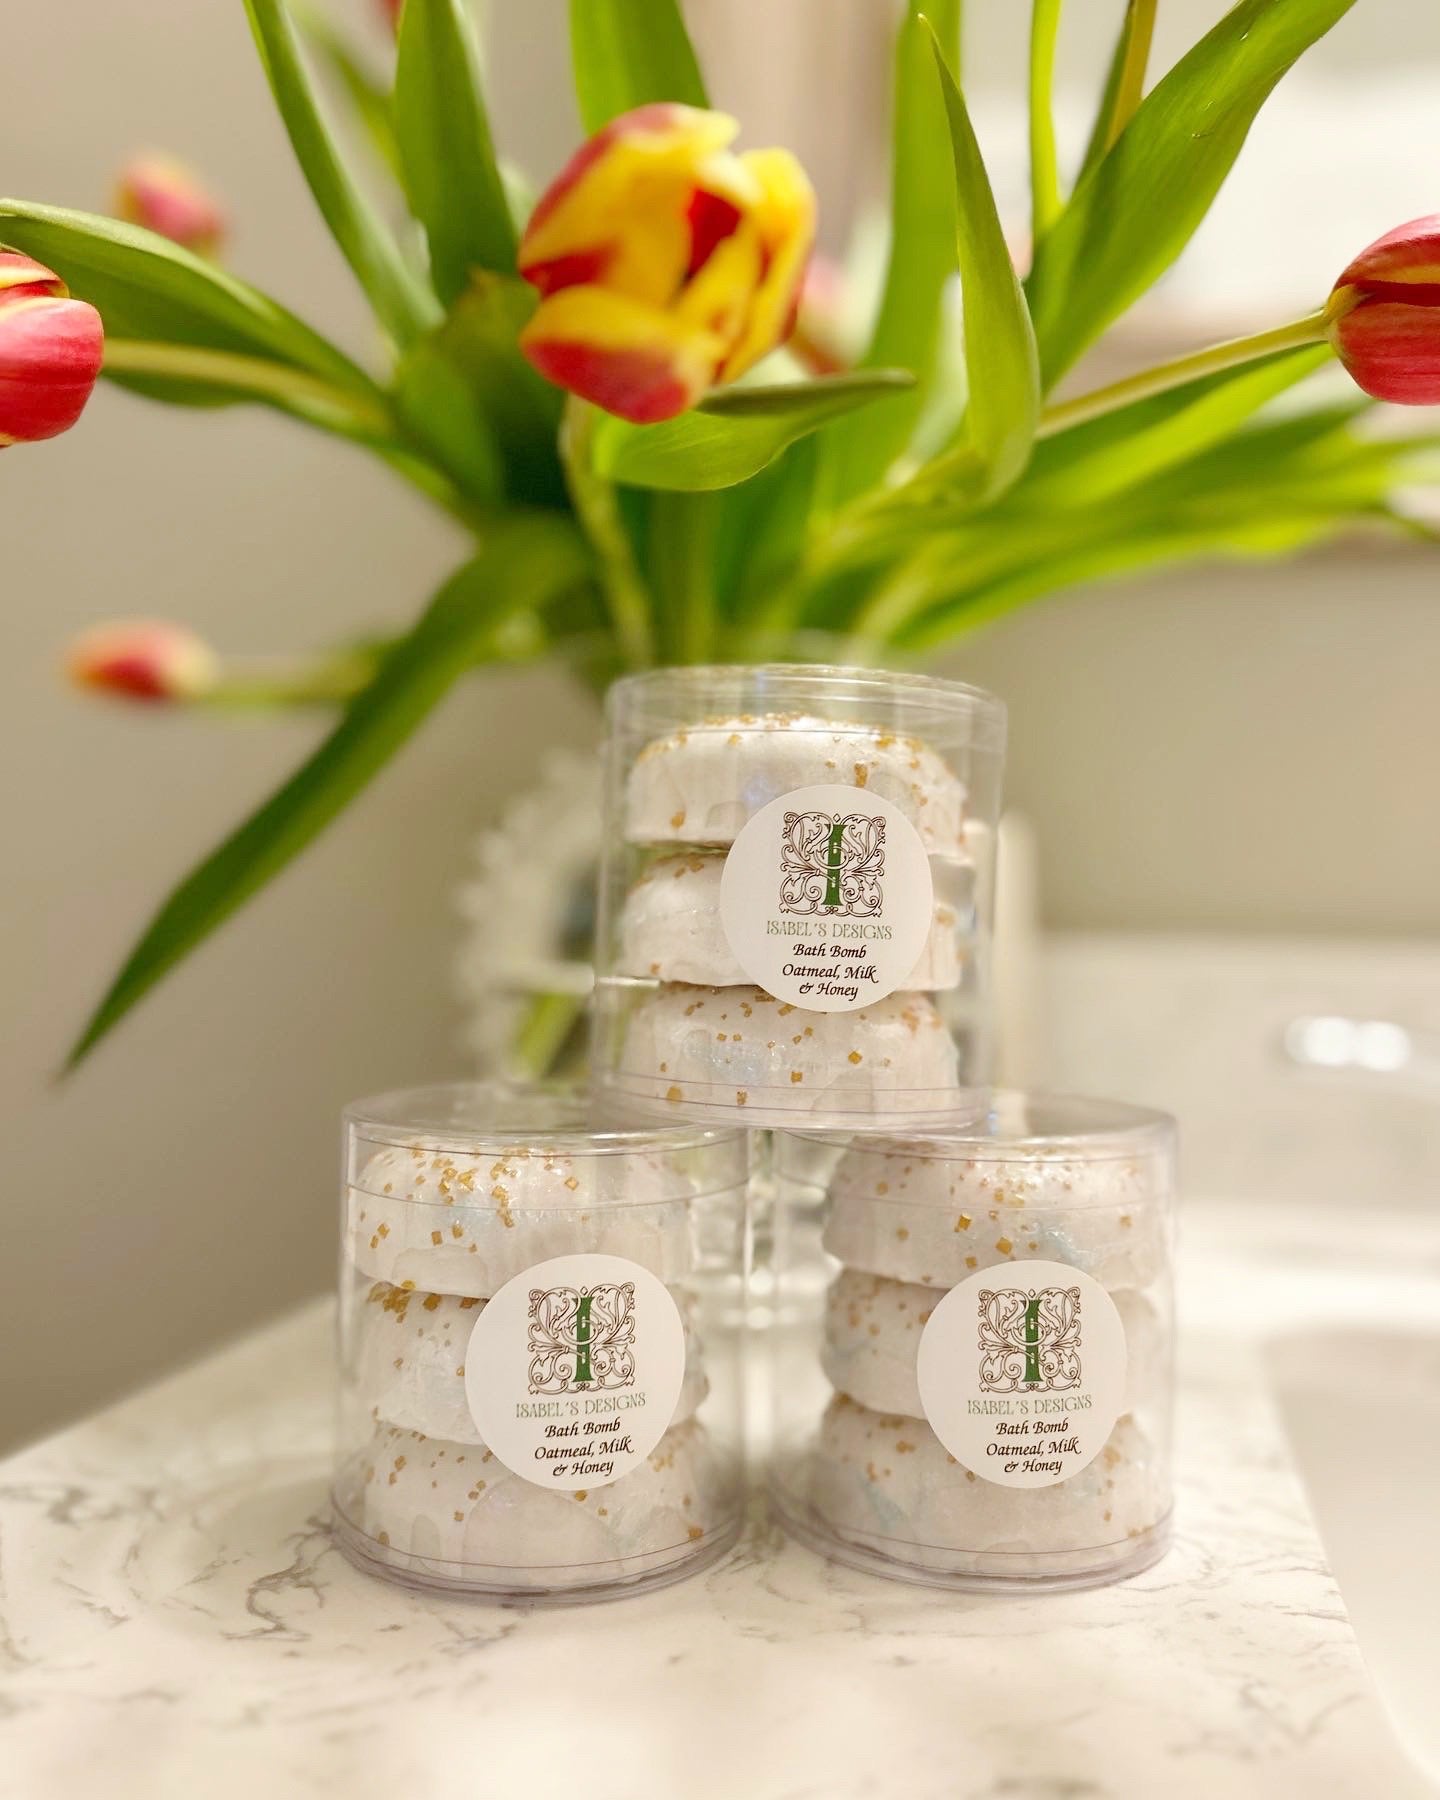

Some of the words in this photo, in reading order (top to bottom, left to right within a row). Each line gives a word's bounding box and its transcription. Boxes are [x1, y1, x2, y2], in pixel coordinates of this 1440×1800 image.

[767, 920, 827, 937] ISABEL'S
[832, 923, 892, 940] DESIGNS
[793, 943, 826, 957] Bath
[830, 945, 866, 958] Bomb
[783, 964, 840, 980] Oatmeal,
[844, 966, 879, 983] Milk
[800, 983, 814, 994] &
[817, 983, 858, 1001] Honey
[516, 1401, 579, 1418] ISABEL'S
[585, 1392, 646, 1415] DESIGNS
[968, 1399, 1028, 1415] ISABEL'S
[1034, 1394, 1092, 1414] DESIGNS
[545, 1421, 579, 1438] Bath
[583, 1417, 621, 1435] Bomb
[996, 1420, 1029, 1435] Bath
[1033, 1417, 1069, 1433] Bomb
[535, 1443, 595, 1459] Oatmeal,
[599, 1435, 634, 1454] Milk
[986, 1440, 1044, 1456] Oatmeal,
[1048, 1436, 1081, 1454] Milk
[553, 1465, 567, 1476] &
[571, 1460, 613, 1477] Honey
[1004, 1462, 1018, 1472] &
[1022, 1459, 1062, 1475] Honey
